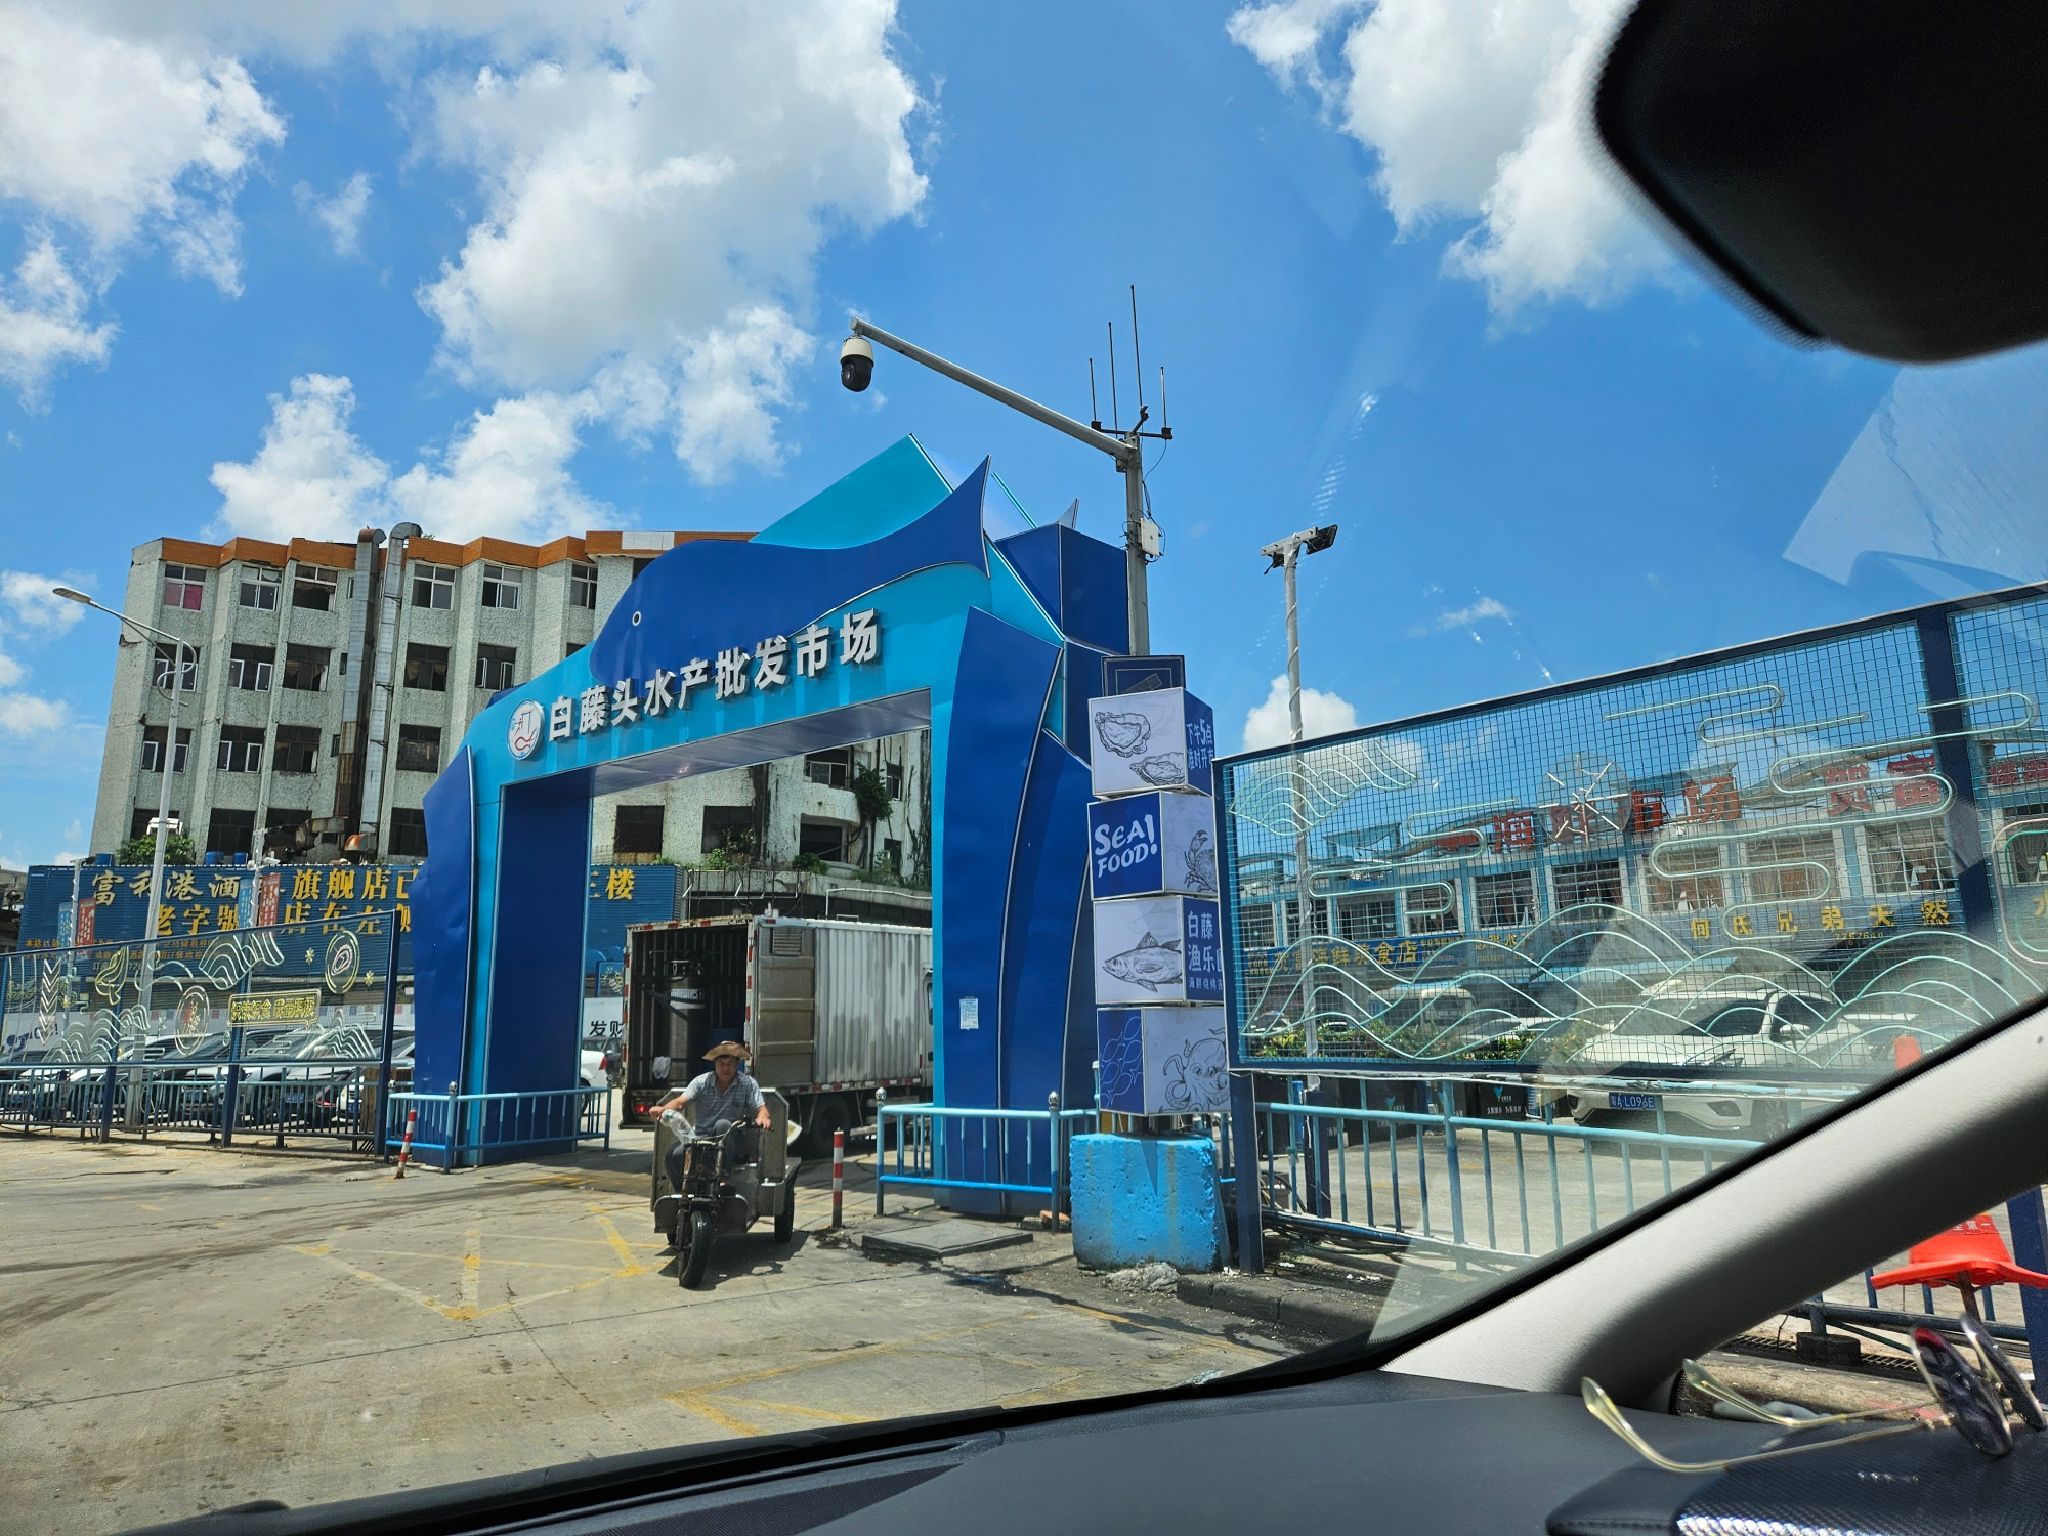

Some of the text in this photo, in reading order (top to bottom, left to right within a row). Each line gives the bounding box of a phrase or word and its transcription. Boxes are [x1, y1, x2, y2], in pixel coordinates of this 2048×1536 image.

[549, 607, 882, 742] 白藤头水产批发市场
[1186, 718, 1214, 745] 下午5点
[1098, 843, 1149, 878] FOOD
[1188, 910, 1213, 939] 白藤
